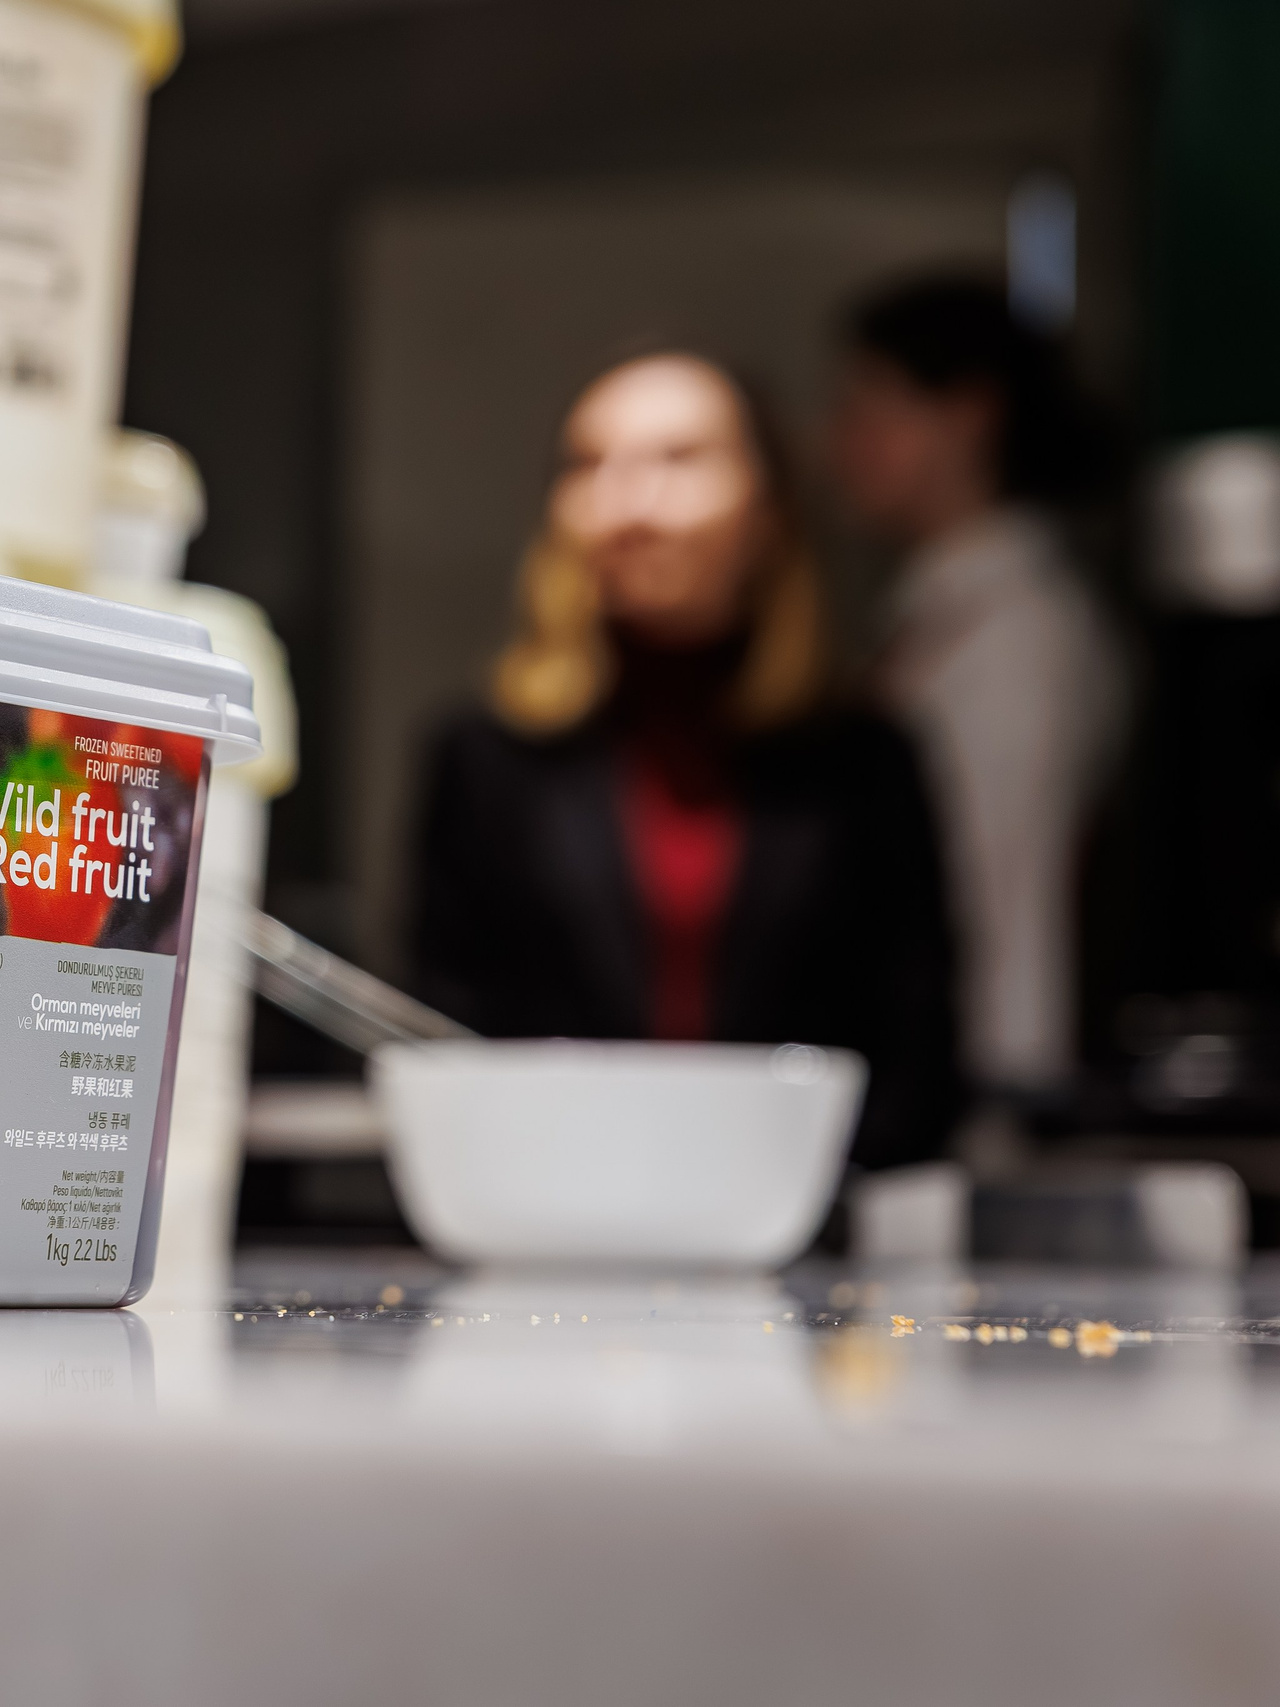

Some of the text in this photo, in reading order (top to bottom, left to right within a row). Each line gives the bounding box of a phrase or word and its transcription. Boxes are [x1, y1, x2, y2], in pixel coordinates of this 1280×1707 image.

[75, 736, 162, 763] FROZEN SWEETENED
[85, 759, 160, 789] FRUIT PUREE
[72, 793, 156, 851] fruit
[69, 845, 152, 903] fruit
[57, 960, 113, 980] DONDURULMUŞ
[91, 981, 115, 995] MEYVE
[31, 993, 141, 1021] Orman meyveleri
[17, 1013, 140, 1040] ve Kırmızı meyveler
[59, 1050, 136, 1072] 含糖冷冻水果泥
[71, 1076, 133, 1098] 野果和红果
[88, 1111, 130, 1130] 냉동 퓨레
[4, 1129, 128, 1152] 와일드 후루츠 와 적색 후루츠
[62, 1170, 74, 1181] Net
[53, 1184, 69, 1196] Peso
[20, 1198, 46, 1213] Καθαρό
[47, 1233, 117, 1266] 1kg 2.2 Lbs
